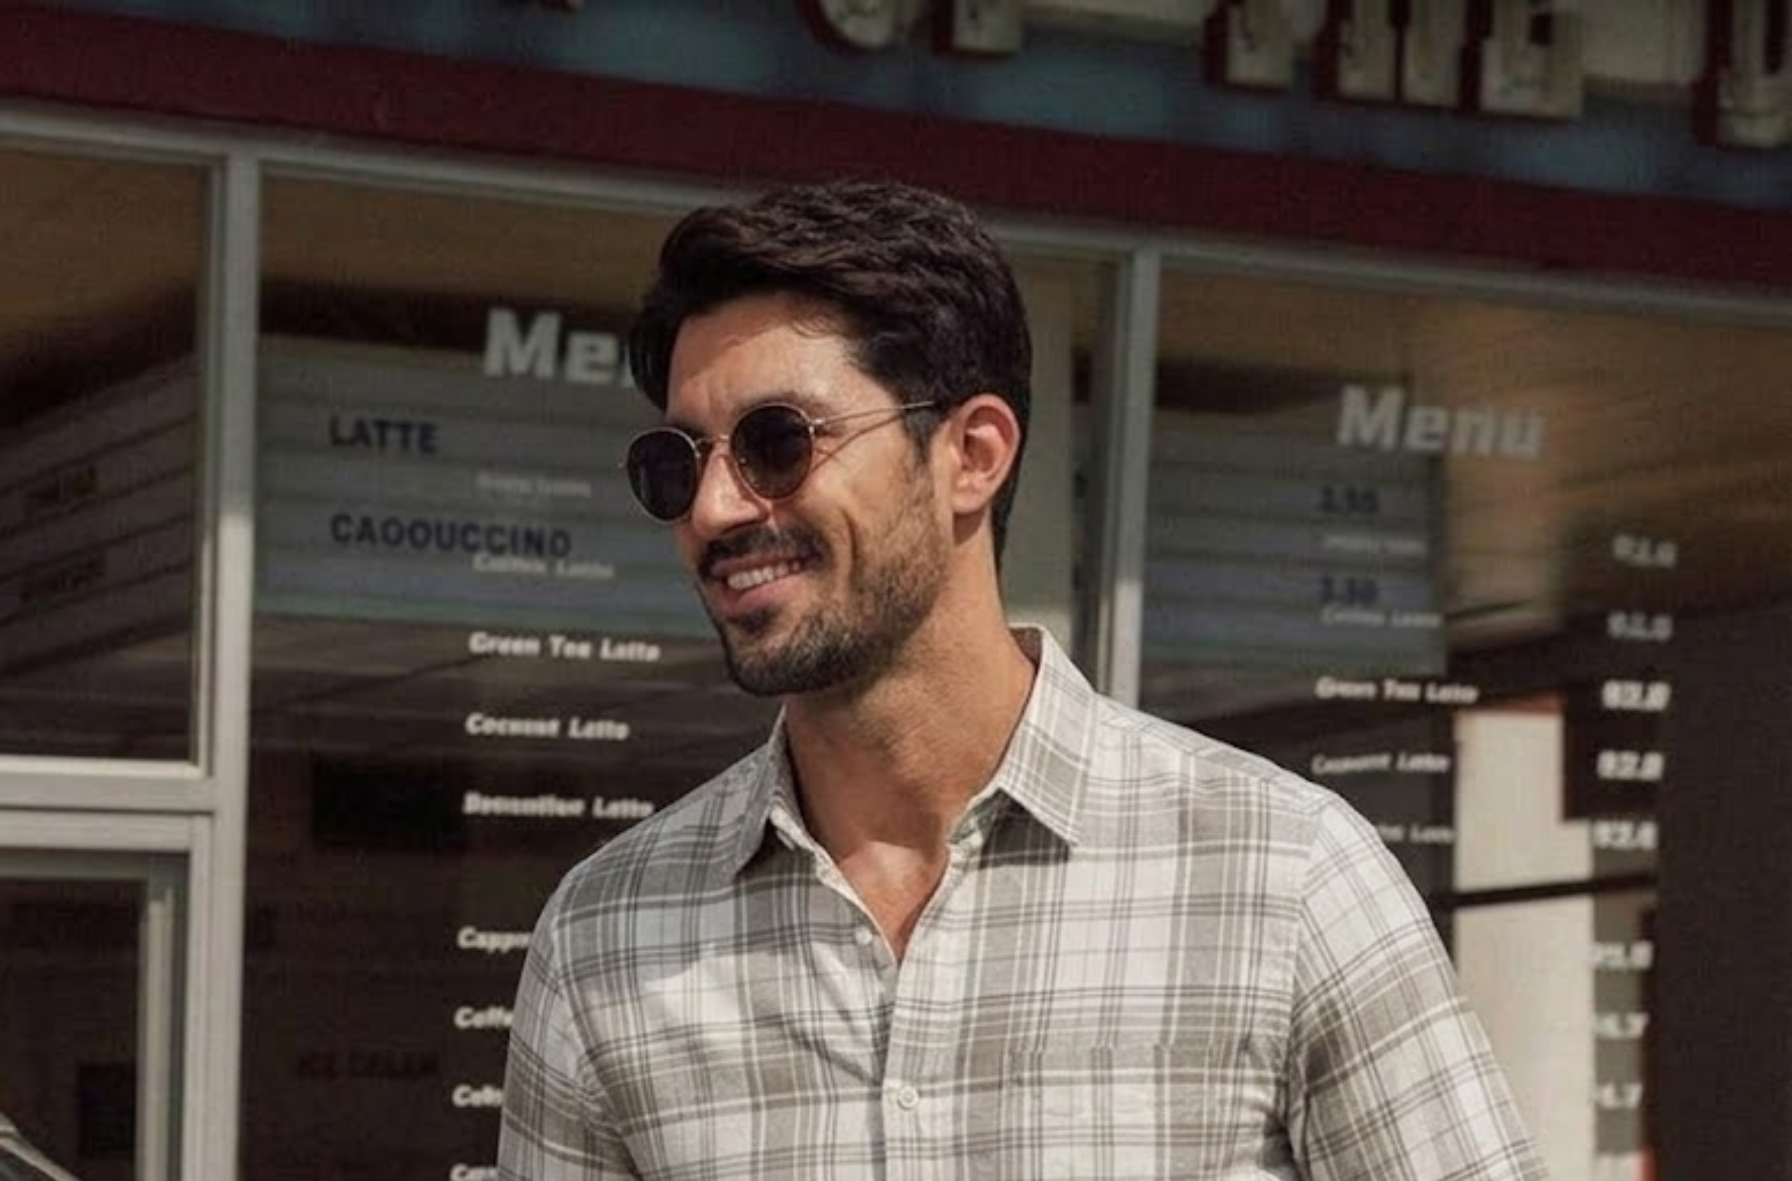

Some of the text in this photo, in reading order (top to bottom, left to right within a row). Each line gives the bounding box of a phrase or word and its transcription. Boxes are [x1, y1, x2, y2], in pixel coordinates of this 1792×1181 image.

[328, 415, 440, 455] LATTE
[1336, 383, 1547, 463] Menu
[468, 631, 541, 656] Green
[599, 638, 661, 663] Latte
[568, 717, 630, 741] Latte
[592, 797, 655, 819] Latte
